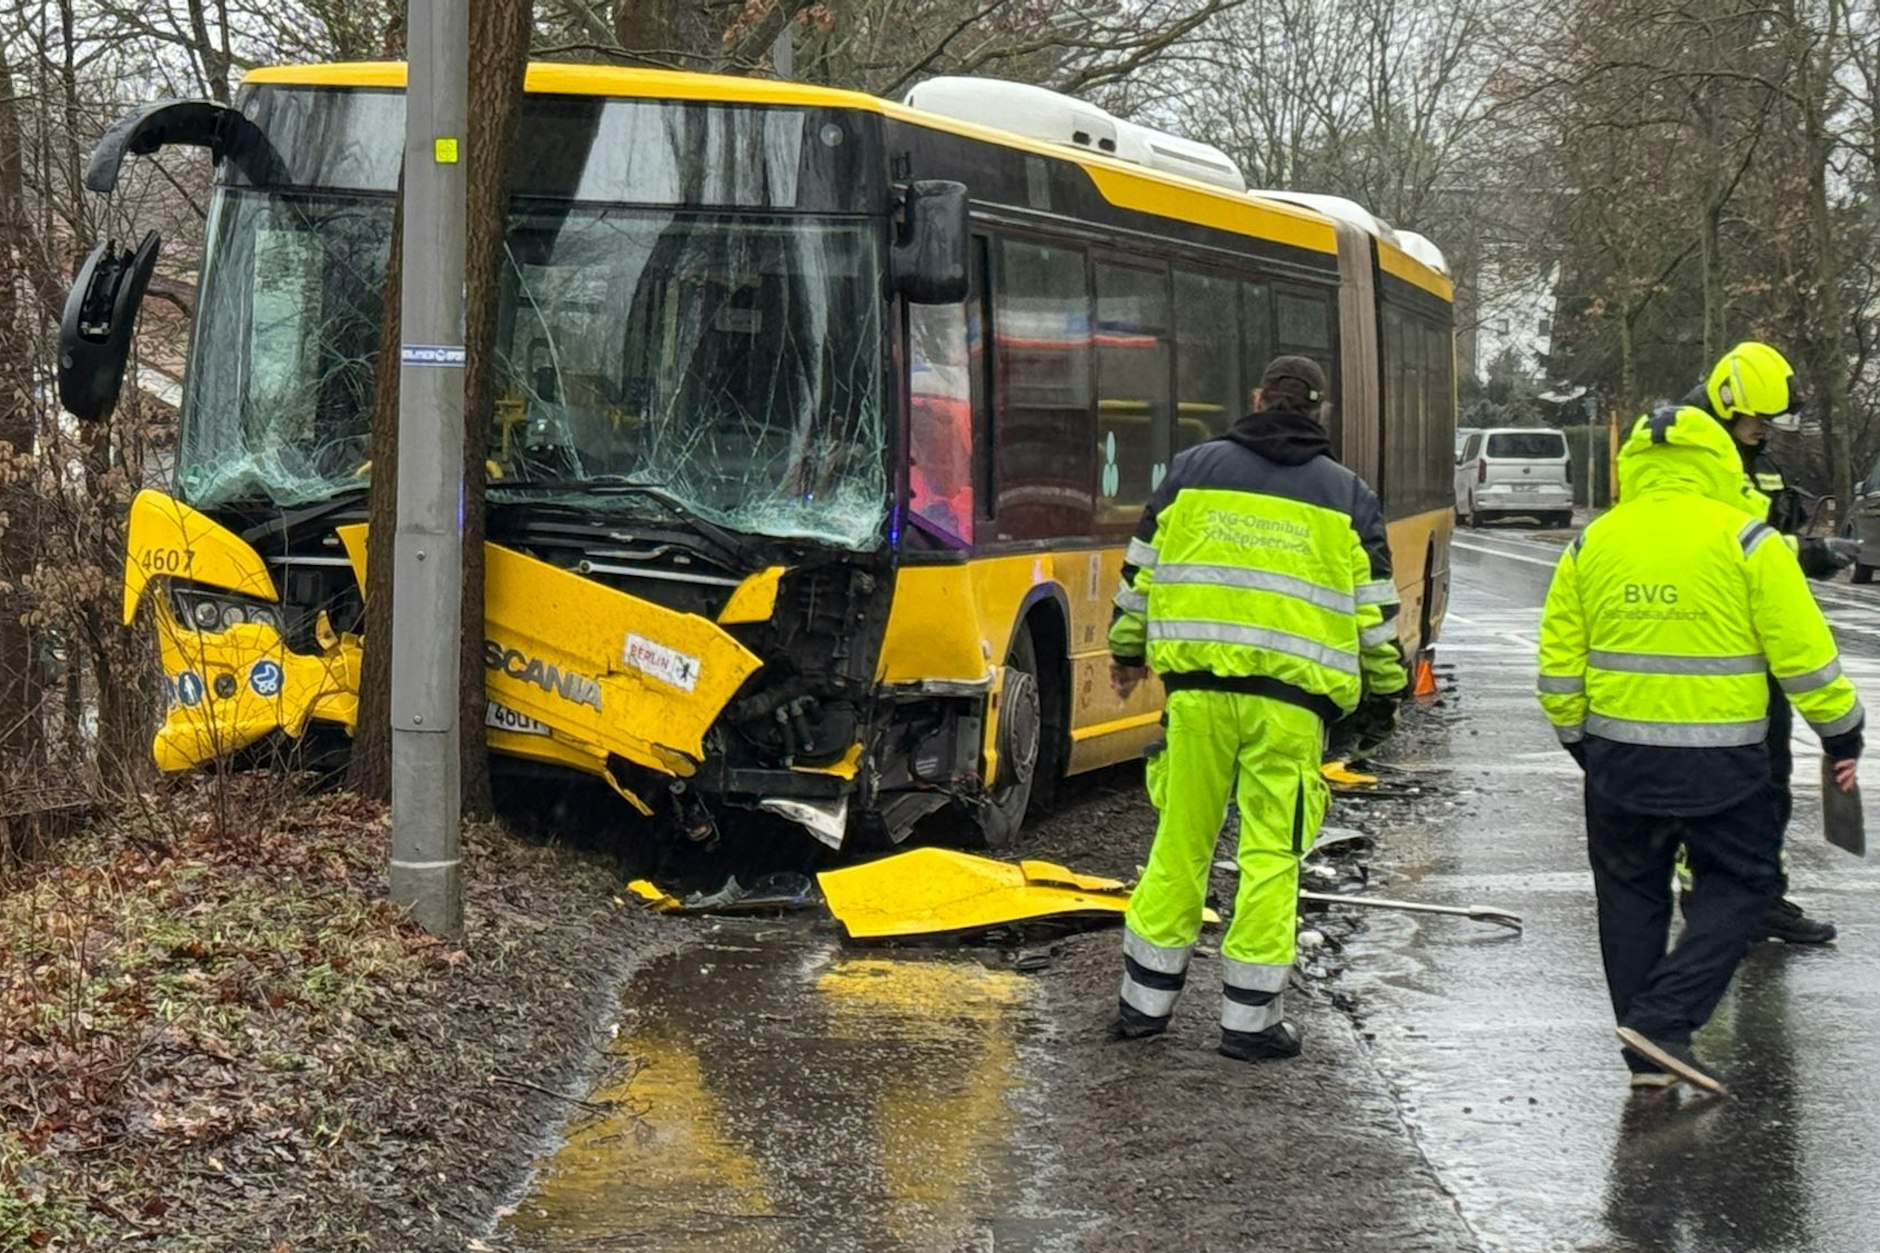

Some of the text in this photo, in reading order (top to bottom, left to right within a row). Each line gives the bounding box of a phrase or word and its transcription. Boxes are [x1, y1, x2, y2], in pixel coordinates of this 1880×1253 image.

[141, 548, 195, 572] 4607
[1624, 584, 1678, 604] BVG
[630, 643, 670, 669] BERLIN
[484, 640, 602, 713] SCANIA
